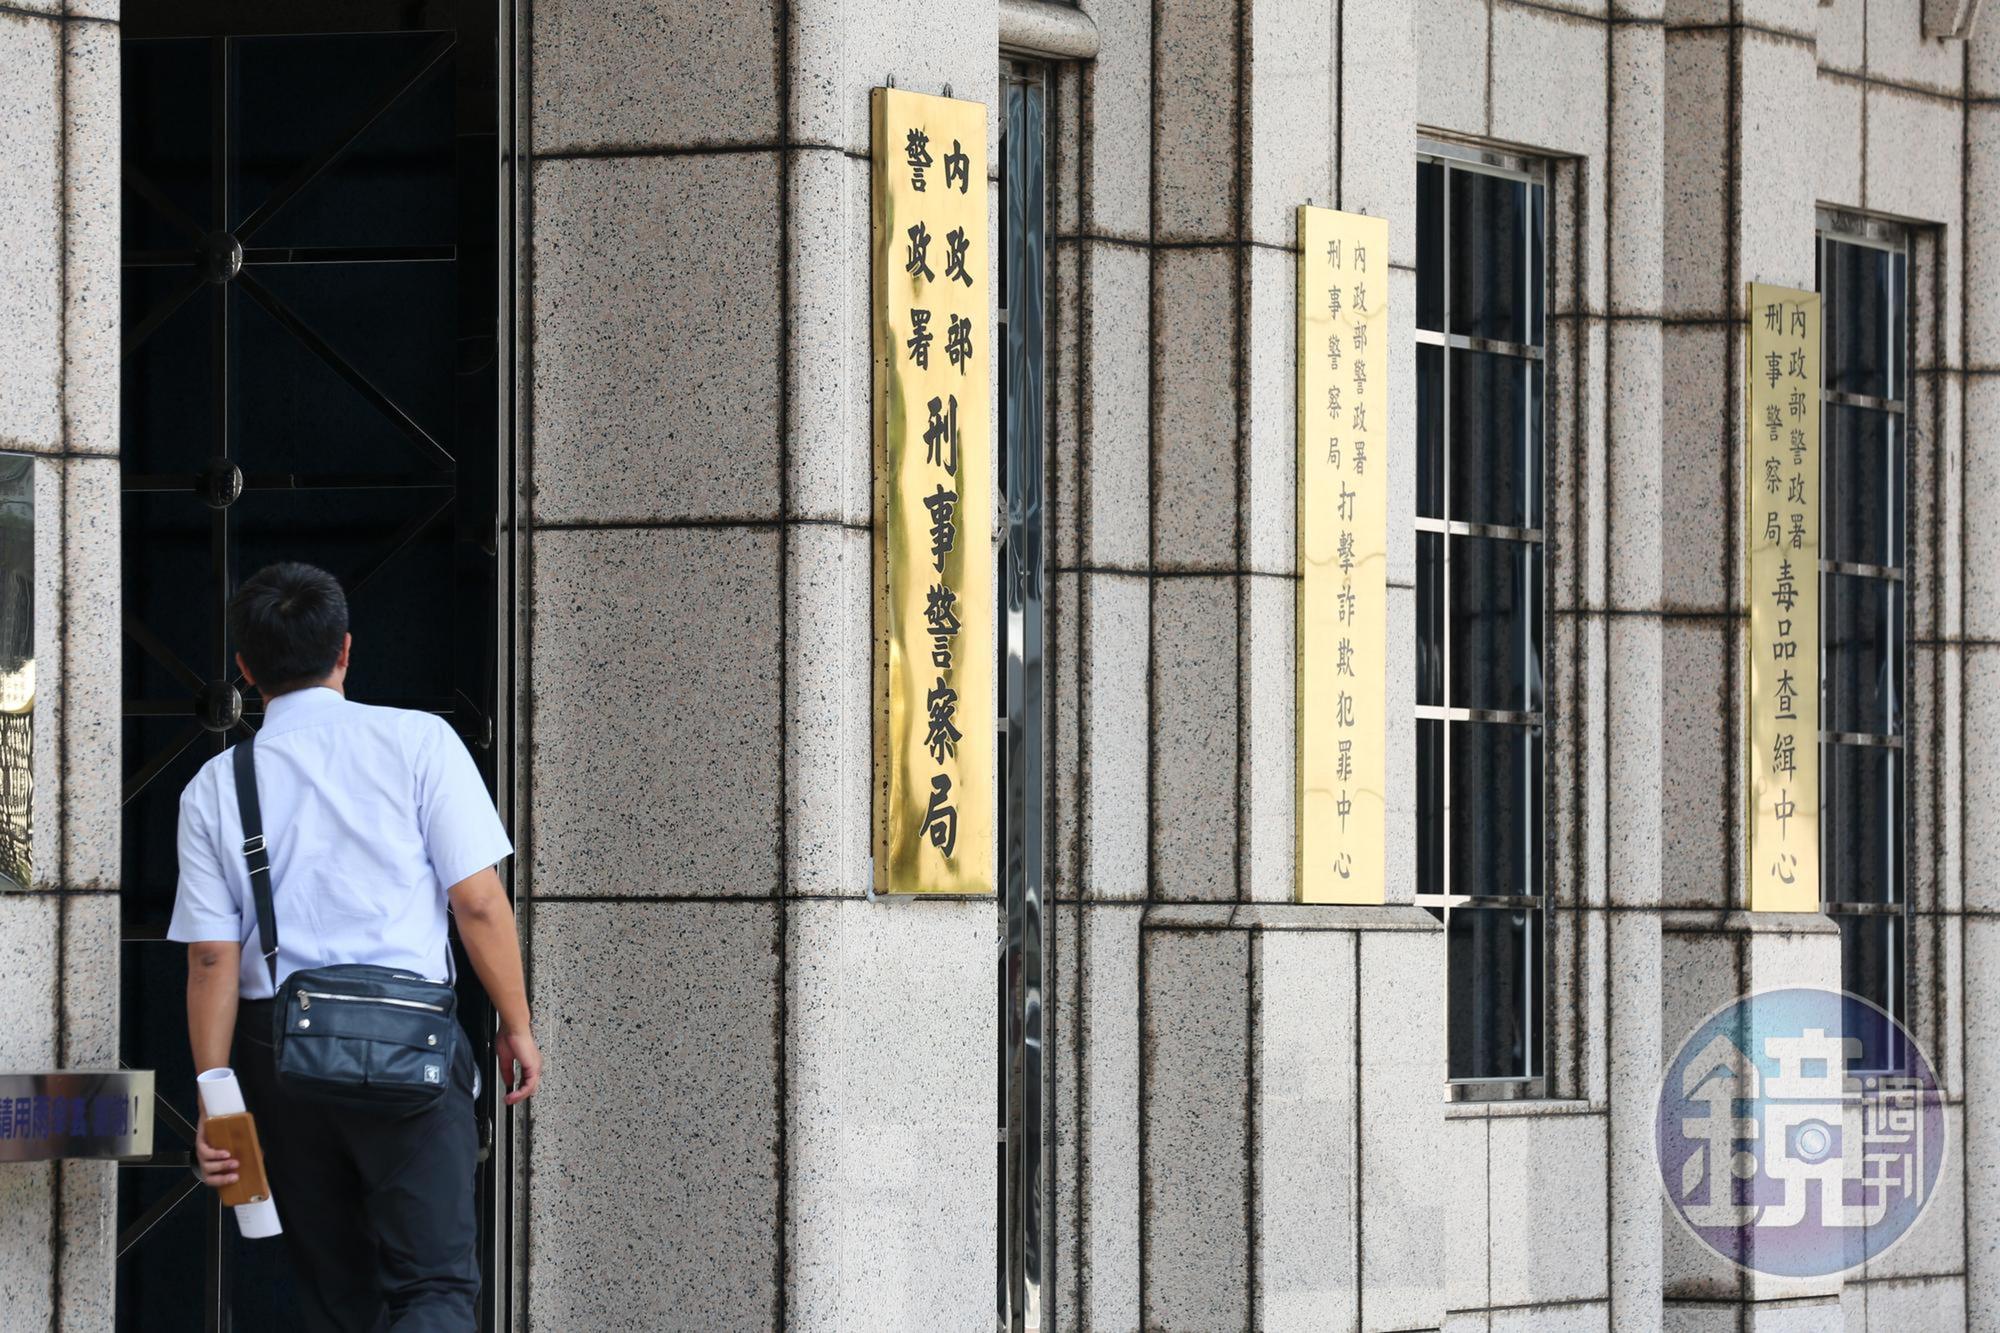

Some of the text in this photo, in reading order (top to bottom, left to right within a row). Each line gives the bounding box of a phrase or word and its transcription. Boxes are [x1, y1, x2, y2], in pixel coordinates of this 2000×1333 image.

[904, 126, 936, 372] 警政署
[1326, 238, 1341, 471] 刑事警察局
[1764, 302, 1783, 547] 刑事警察局
[919, 393, 963, 859] 刑事警察局
[1333, 480, 1356, 879] 打擊詐欺犯罪中心
[1771, 558, 1799, 885] 毒品查緝中心
